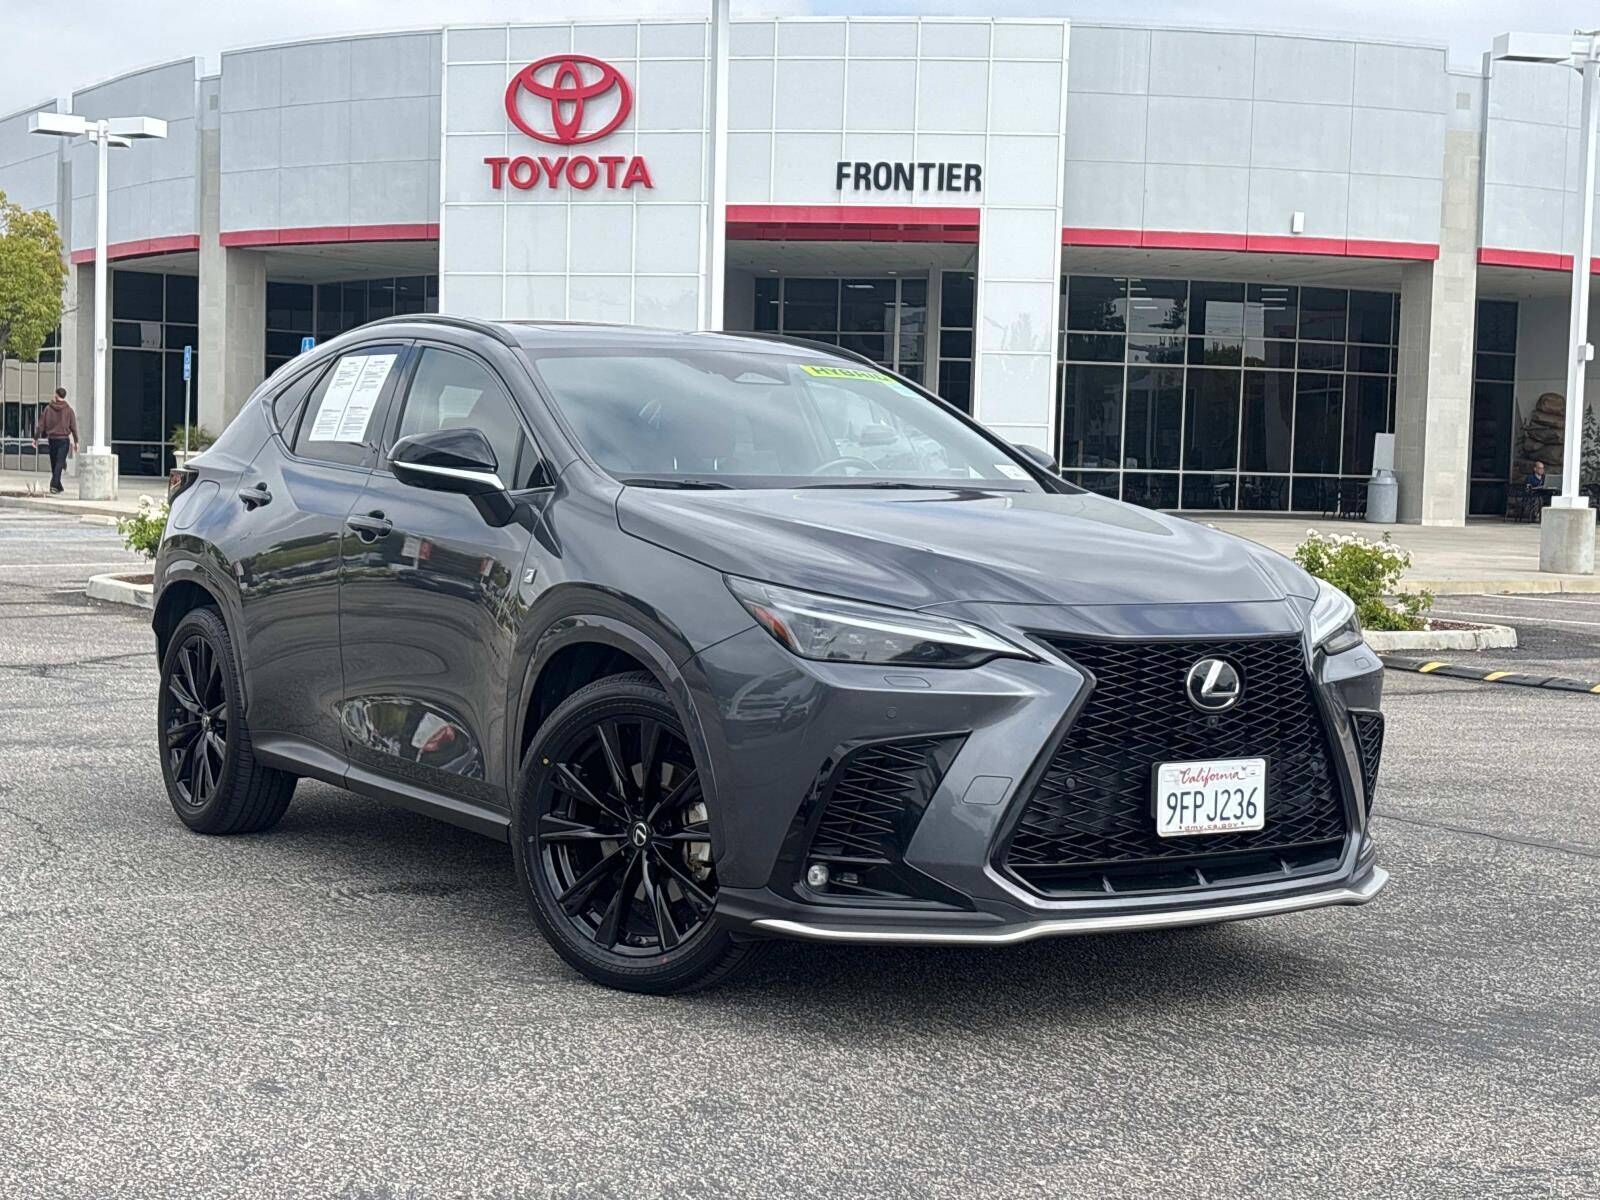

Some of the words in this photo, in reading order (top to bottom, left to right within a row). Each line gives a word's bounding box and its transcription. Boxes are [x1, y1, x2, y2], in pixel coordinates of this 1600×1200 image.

[484, 156, 653, 190] TOYOTA
[836, 161, 982, 192] FRONTIER
[1180, 767, 1246, 787] California
[1166, 787, 1258, 826] 9FPJ236
